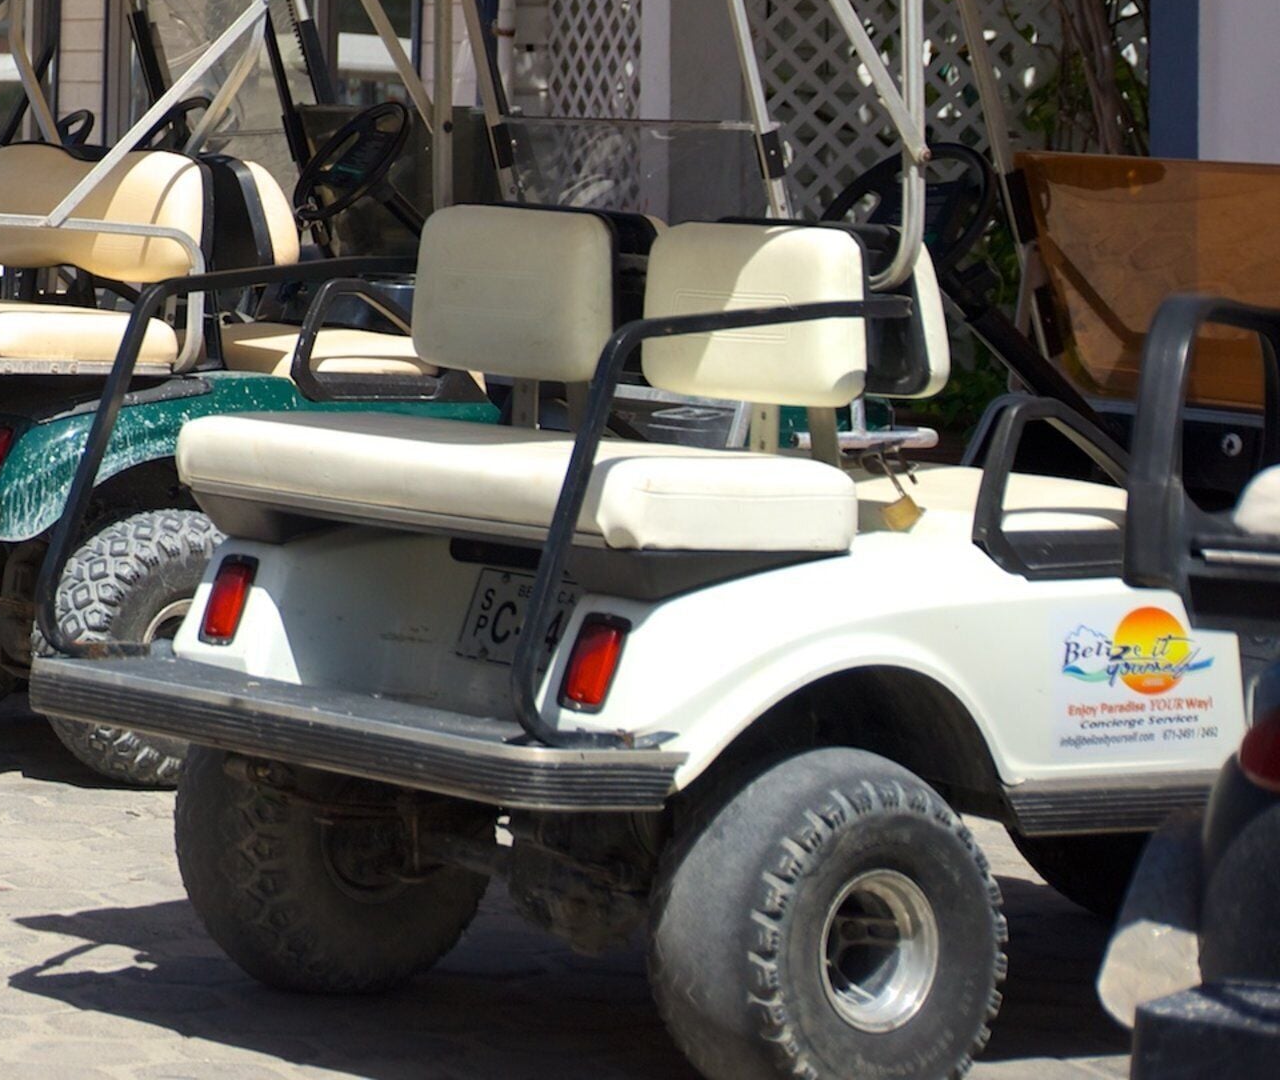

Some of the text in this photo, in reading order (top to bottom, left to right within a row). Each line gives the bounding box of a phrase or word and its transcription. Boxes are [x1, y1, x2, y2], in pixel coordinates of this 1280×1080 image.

[1064, 634, 1196, 667] Belize it
[1068, 696, 1214, 718] Enjoy Paradise YOUR Way!
[1080, 714, 1199, 731] Concierge Services
